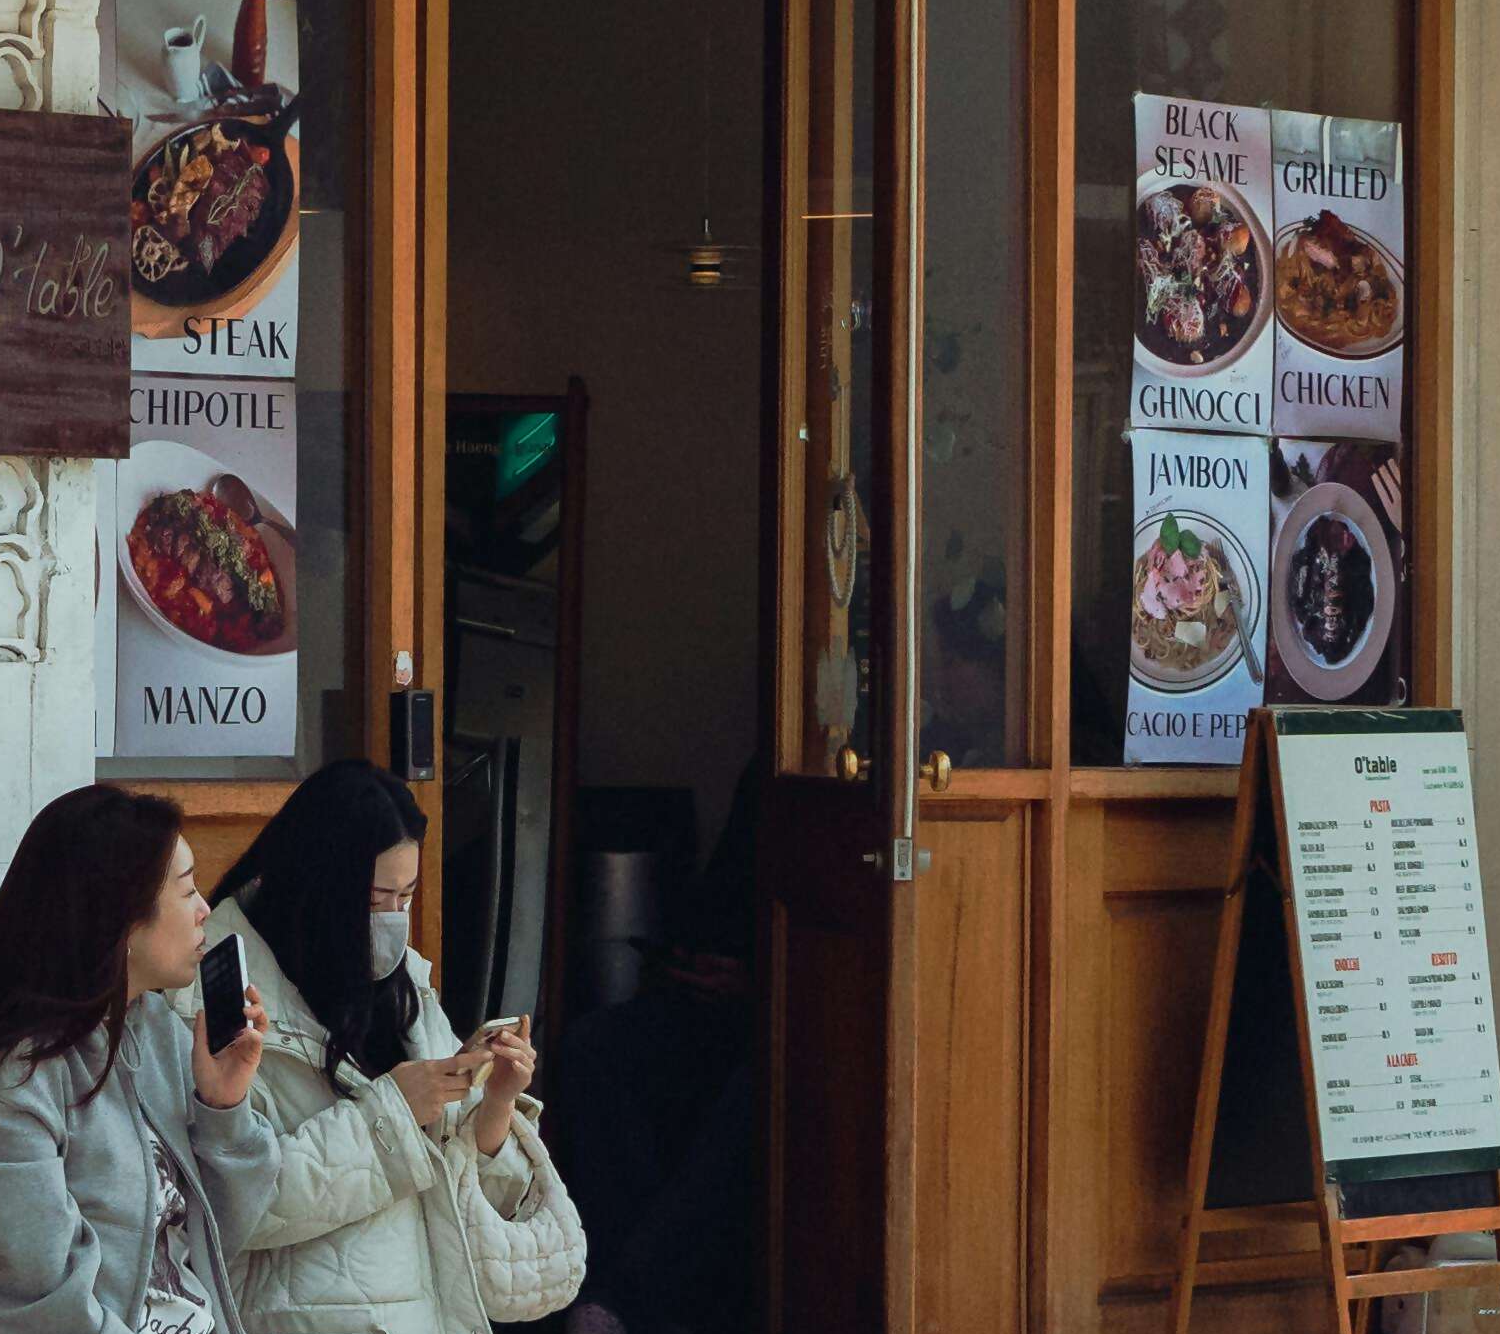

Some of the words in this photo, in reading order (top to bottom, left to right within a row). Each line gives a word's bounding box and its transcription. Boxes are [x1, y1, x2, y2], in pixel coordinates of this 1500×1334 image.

[1165, 103, 1240, 143] BLACK
[1154, 144, 1249, 186] SESAME
[1282, 159, 1388, 202] GRILLED
[181, 315, 290, 361] STEAK
[130, 387, 286, 431] CHIPOTLE
[1138, 383, 1262, 427] GHNOCCI
[1280, 369, 1391, 410] CHICKEN
[1148, 452, 1249, 497] JAMBON
[143, 685, 268, 725] MANZO
[1126, 712, 1188, 738] CACIO
[1193, 713, 1204, 738] E
